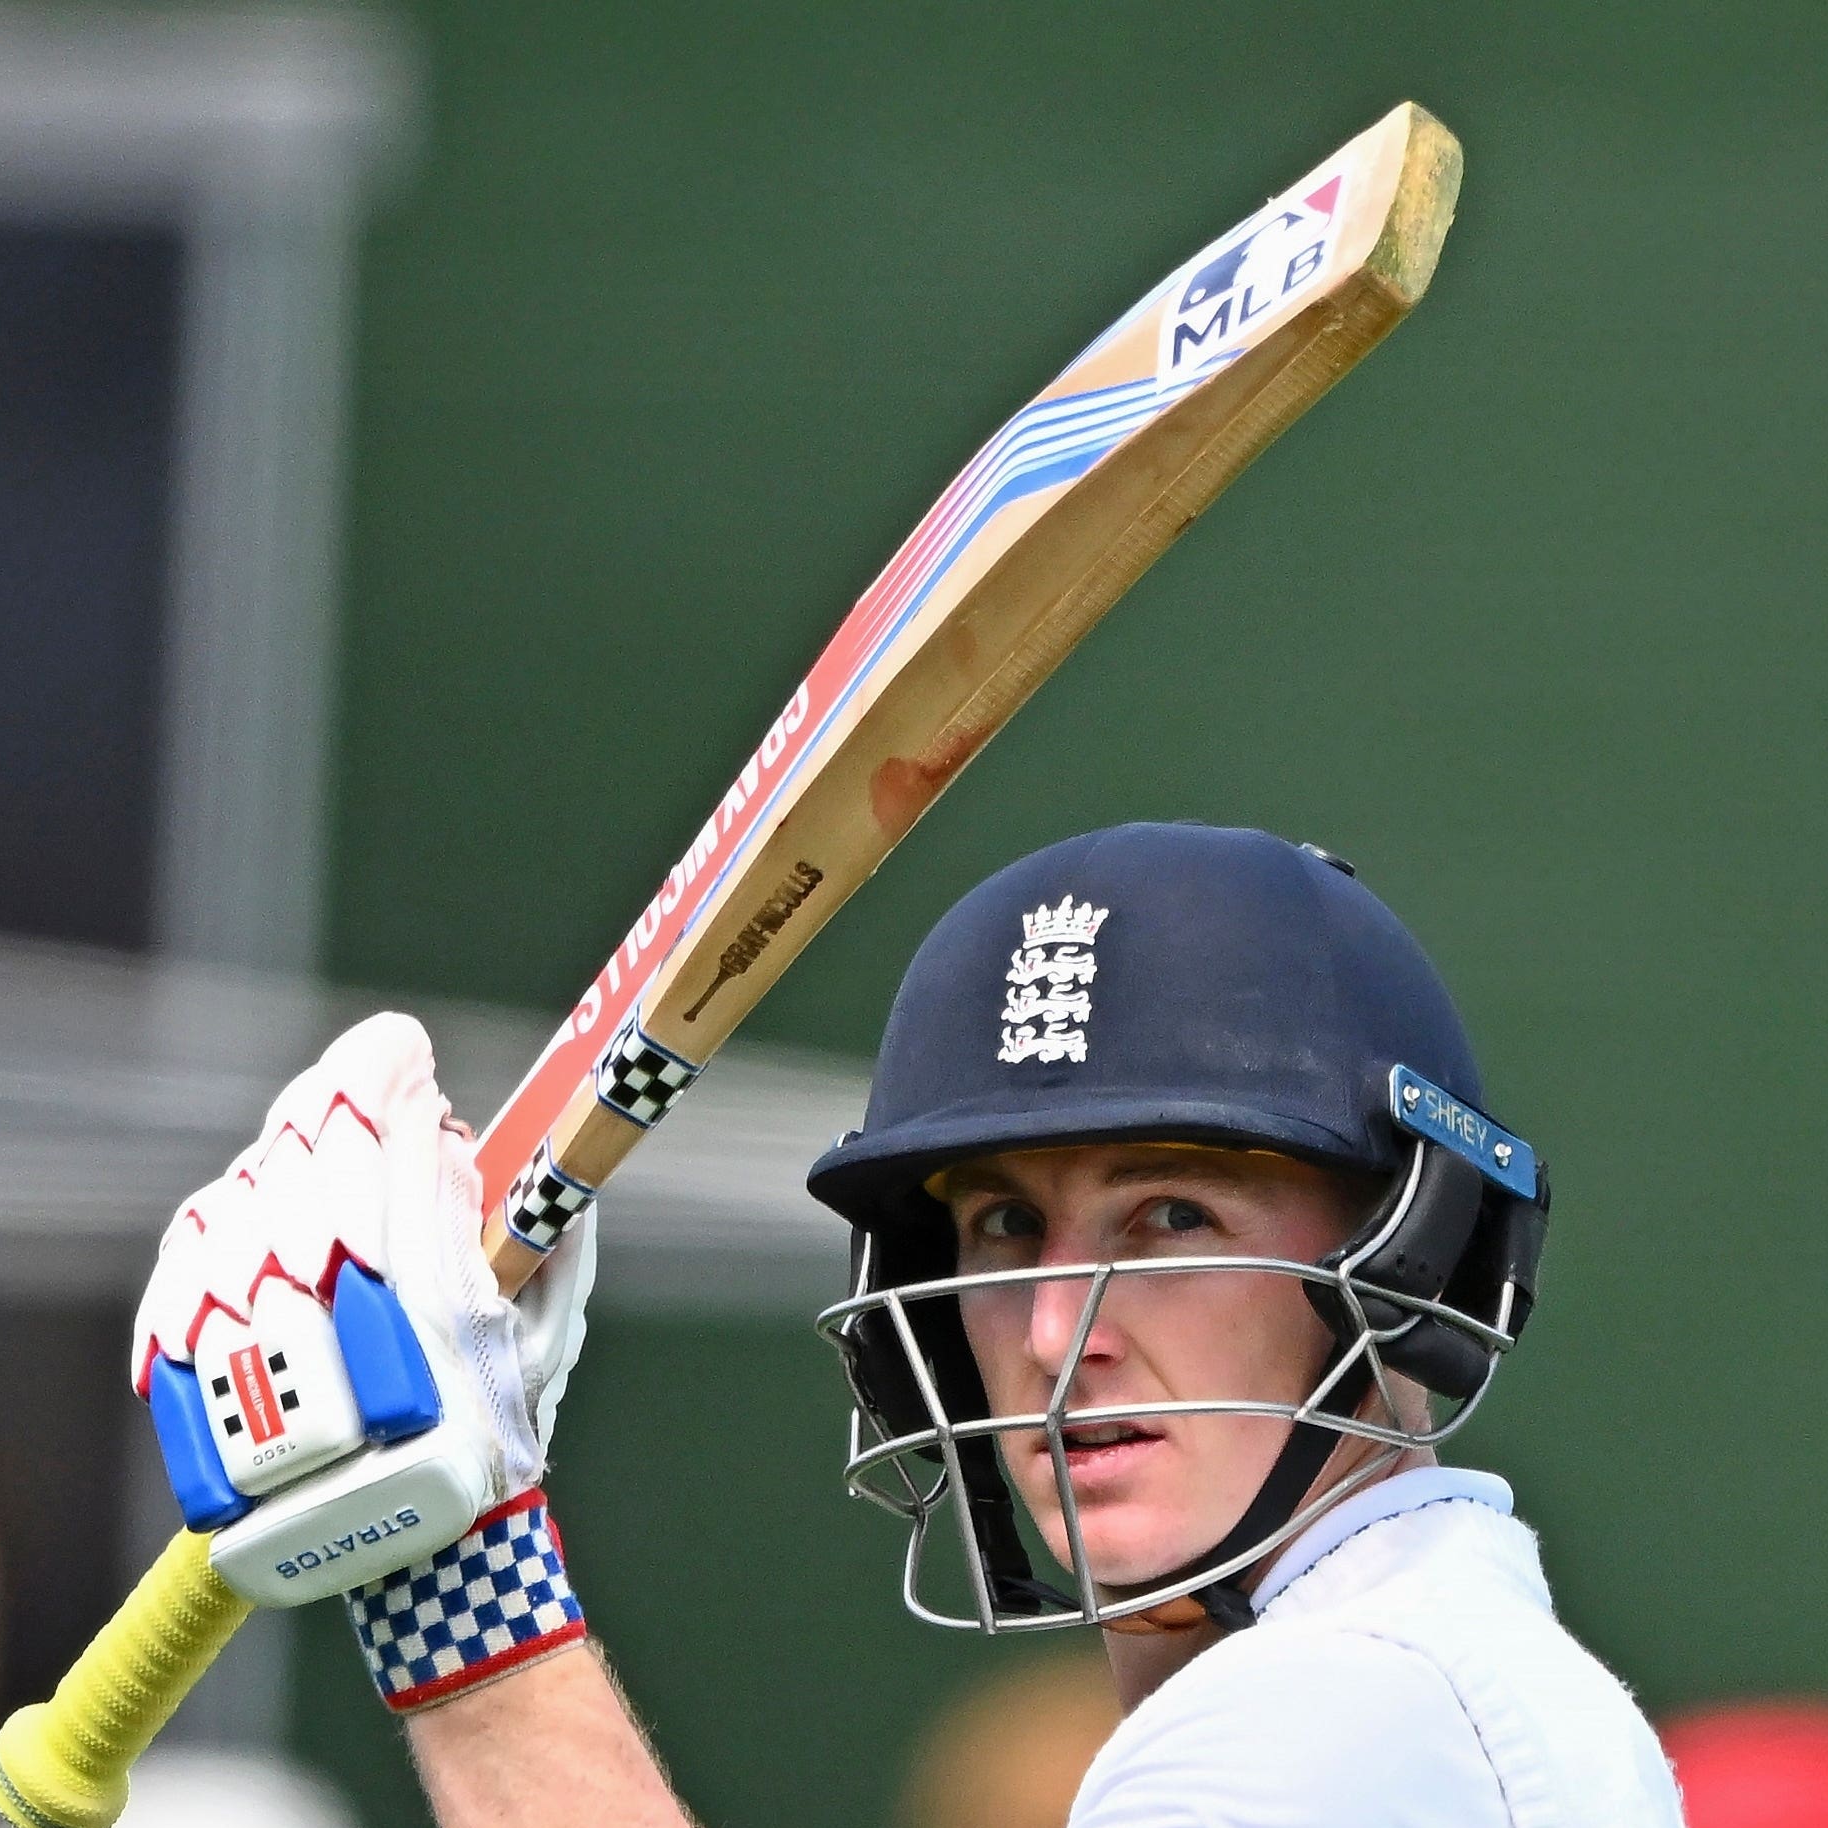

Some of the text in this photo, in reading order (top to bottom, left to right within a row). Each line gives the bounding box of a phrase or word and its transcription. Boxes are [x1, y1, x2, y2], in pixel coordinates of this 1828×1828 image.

[1172, 239, 1325, 368] MLB
[720, 860, 824, 974] GRAY-COLLS
[1424, 1089, 1488, 1150] SHREY
[253, 1441, 297, 1466] 1500
[275, 1506, 422, 1579] STRATOS
